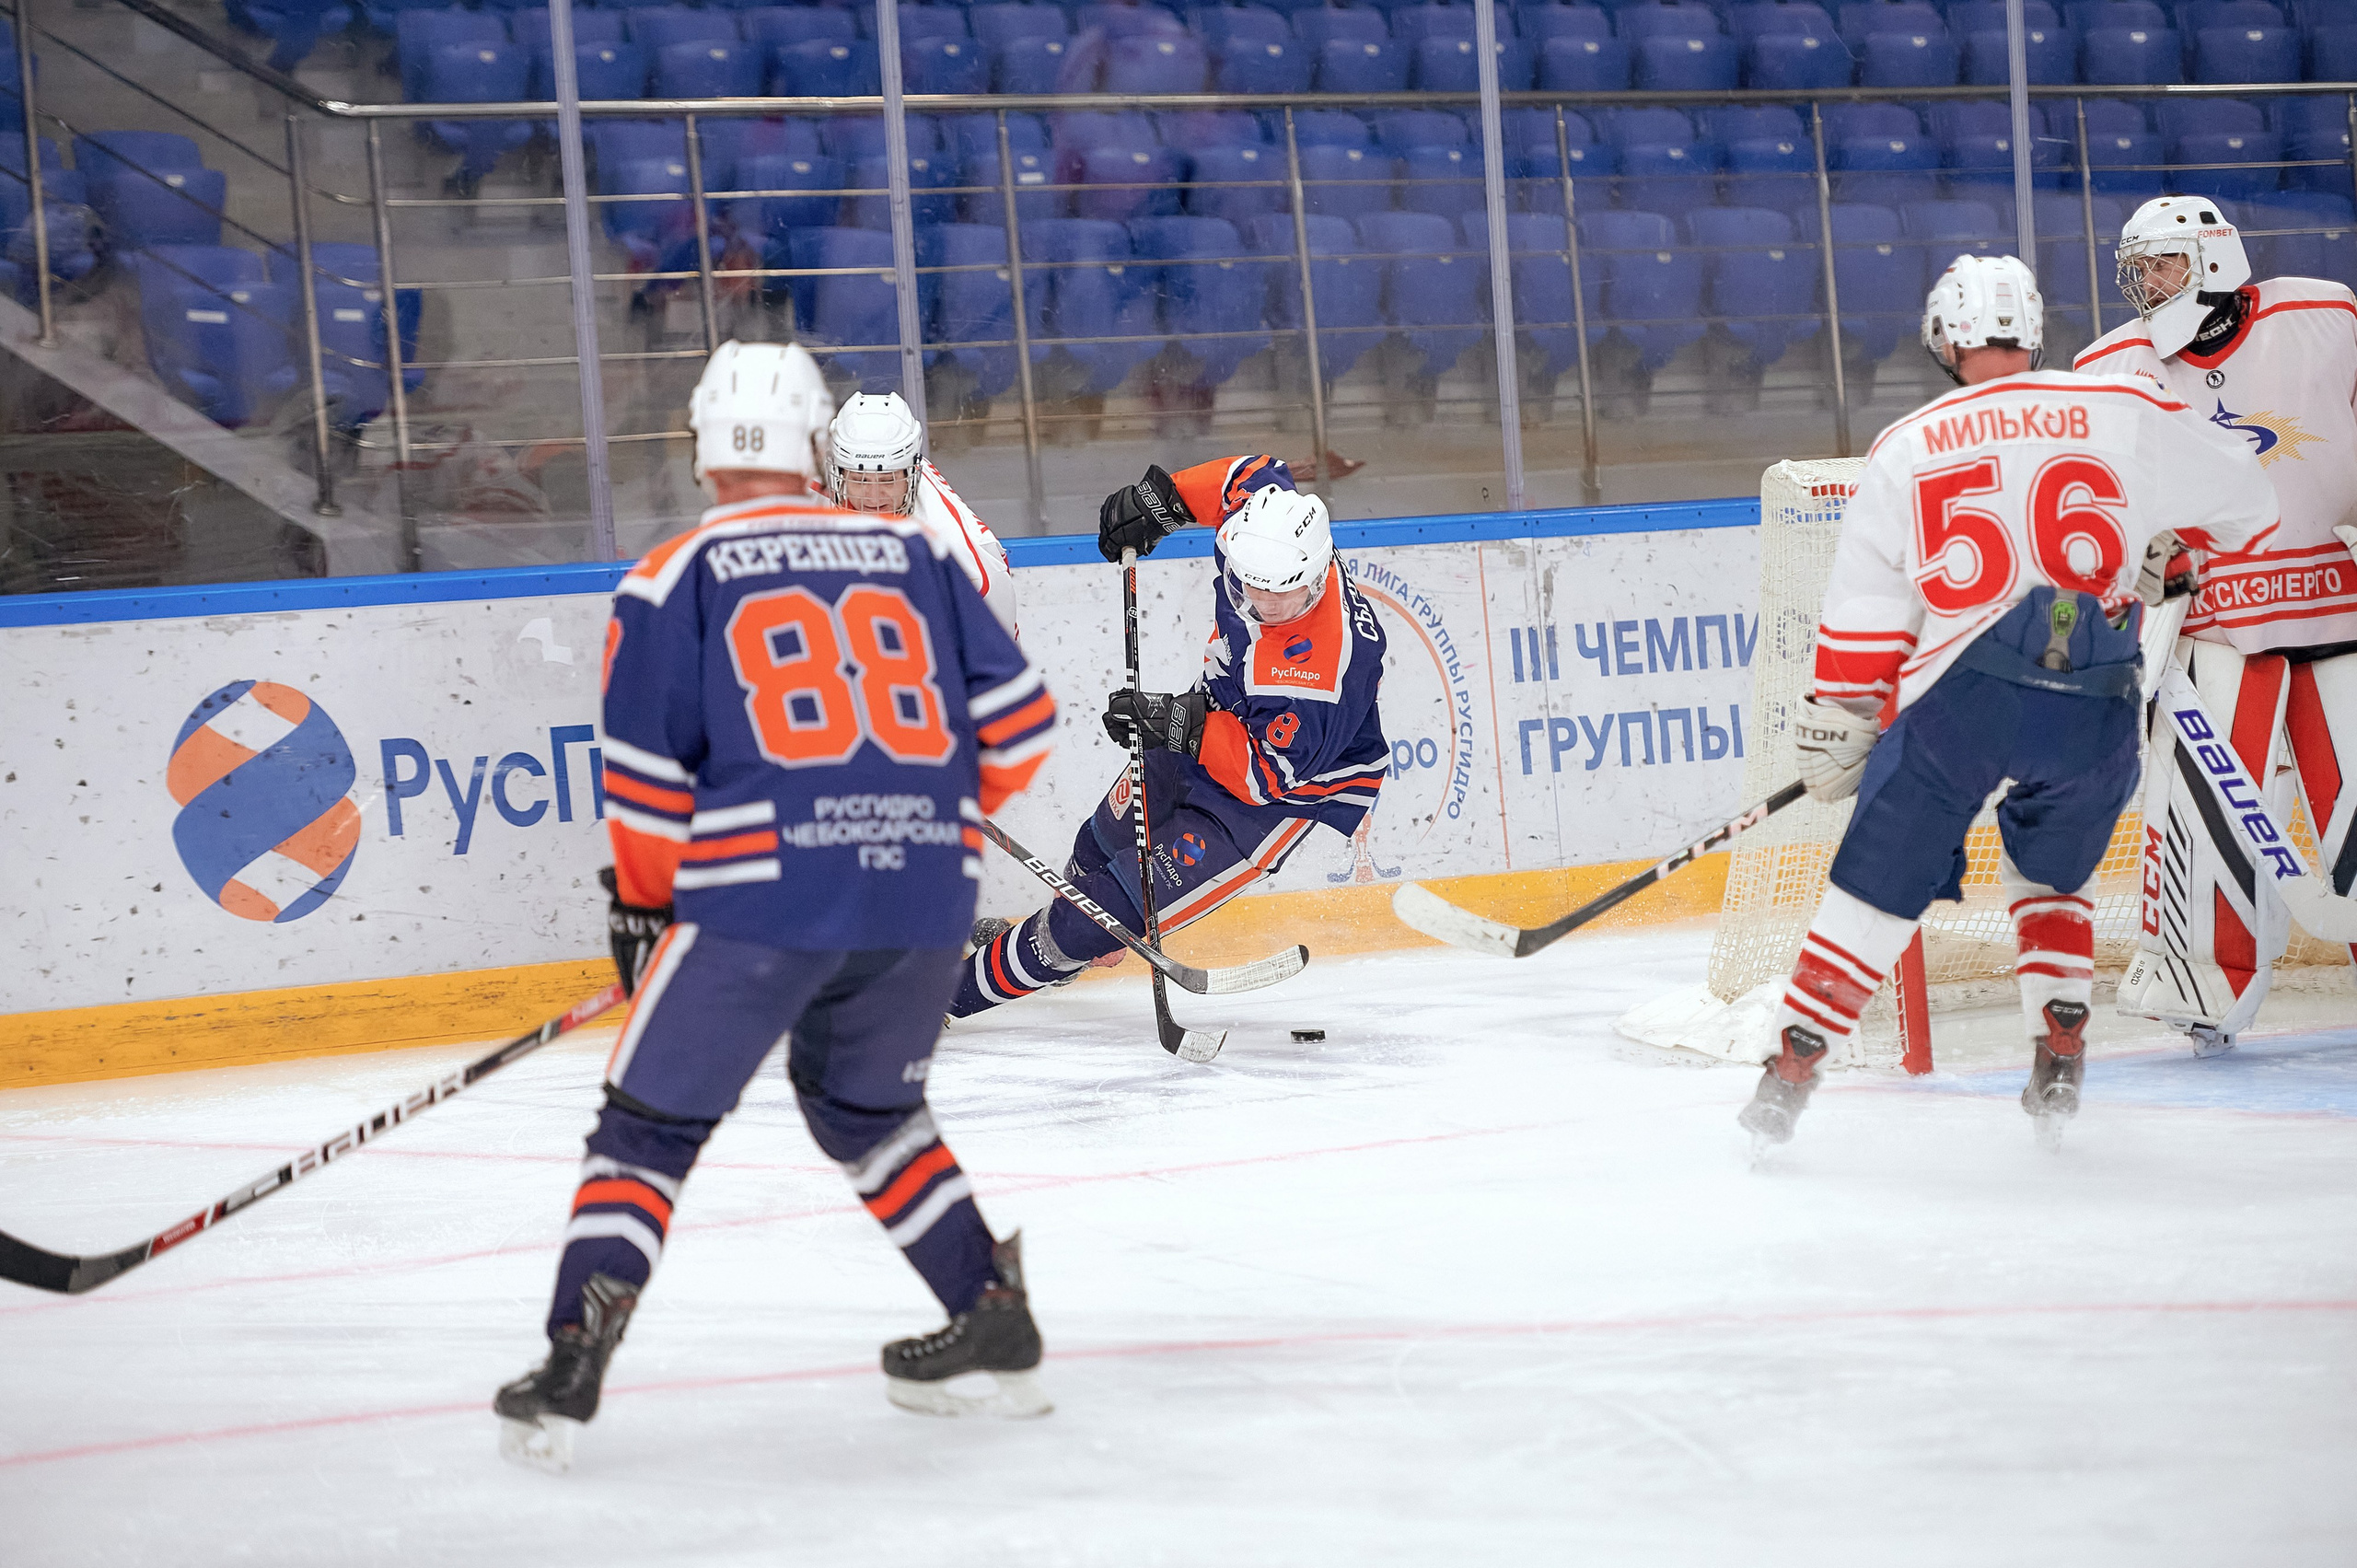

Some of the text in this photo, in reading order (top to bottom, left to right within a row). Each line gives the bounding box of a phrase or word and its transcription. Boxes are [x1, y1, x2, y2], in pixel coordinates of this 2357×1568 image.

[2120, 235, 2140, 246] CCM
[2197, 227, 2234, 238] FONBET
[733, 424, 765, 452] 88
[1922, 403, 2091, 455] МИЛЬКОВ
[1135, 481, 1181, 534] BAUE
[1295, 506, 1318, 539] CCM
[705, 533, 911, 583] КЕРЕНЦЕВ
[1912, 453, 2129, 619] 56
[1244, 573, 1271, 584] CCM
[725, 583, 958, 769] 88
[1271, 667, 1320, 680] РусГидро
[1364, 562, 1474, 819] ЛИГА ГРУППЫ РУСГИДРО
[1266, 712, 1301, 749] 8
[1517, 703, 1746, 775] ГРУППЫ
[814, 794, 936, 820] РУСГИДРО
[2173, 708, 2303, 881] BAUER
[858, 844, 906, 871] ГЭС
[1154, 842, 1183, 888] РусГидро
[1658, 802, 1770, 880] CCM
[1022, 856, 1121, 930] BAUER
[2142, 823, 2164, 937] CCM
